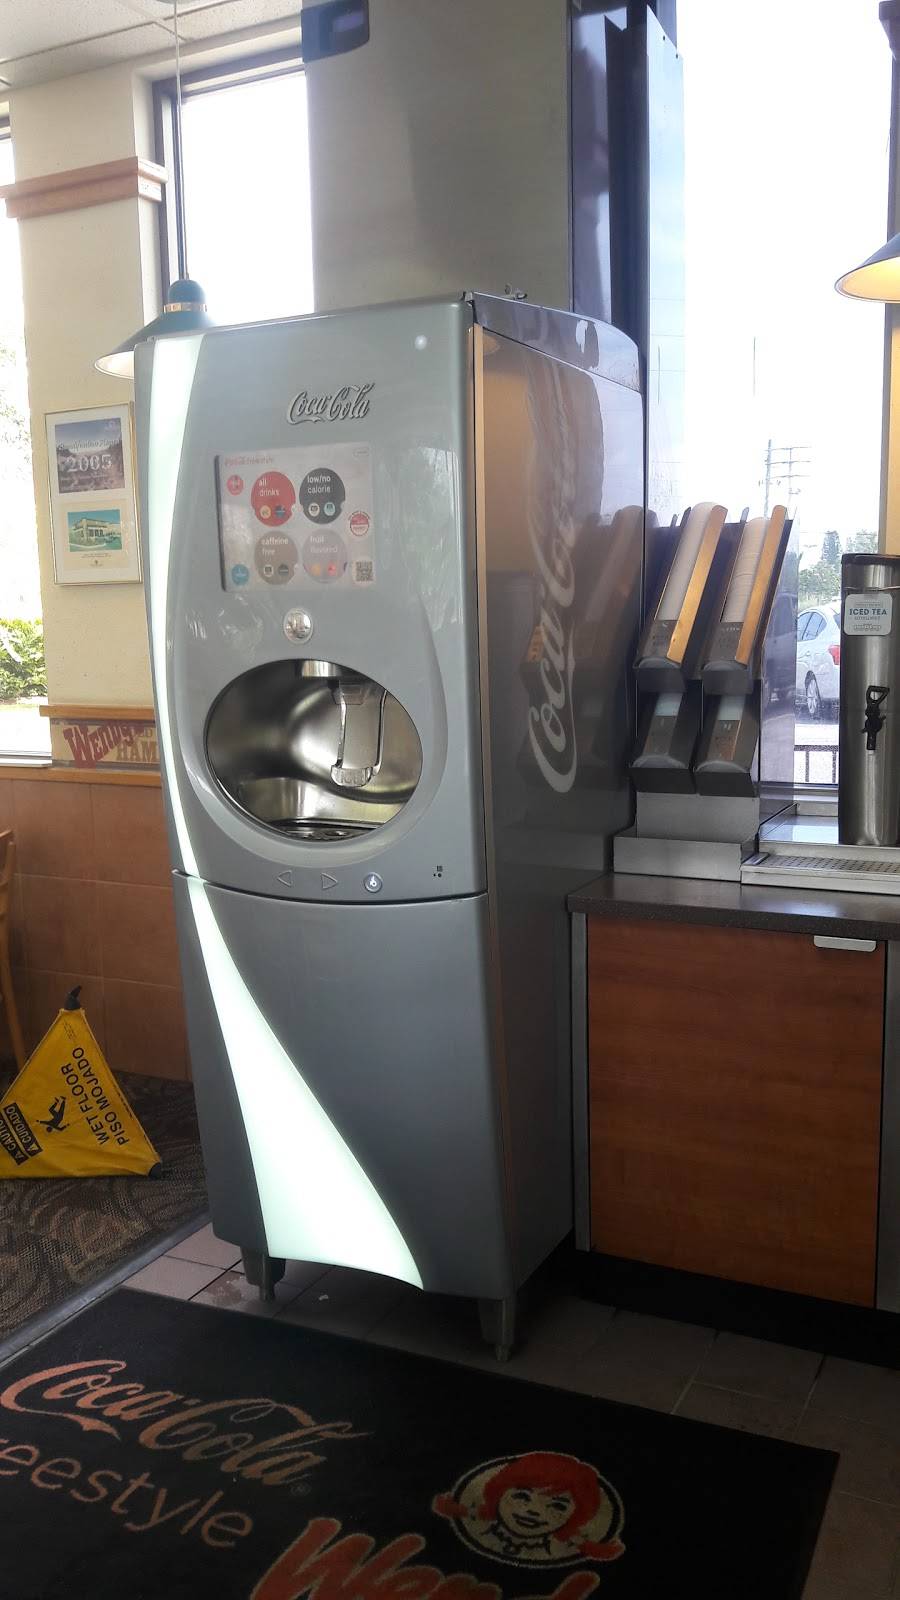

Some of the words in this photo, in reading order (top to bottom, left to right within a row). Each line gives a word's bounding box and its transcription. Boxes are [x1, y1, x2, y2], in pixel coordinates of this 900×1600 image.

[287, 382, 375, 425] Coca-Cola
[258, 478, 268, 487] all
[259, 487, 280, 497] drinks
[307, 474, 331, 484] low/no
[518, 360, 579, 793] Coca-Co
[849, 608, 870, 616] ICED
[871, 608, 888, 616] TEA
[61, 1063, 93, 1113] FLOOR
[72, 1047, 111, 1111] MOJADO
[6, 1106, 32, 1144] CUIDADO
[86, 1115, 110, 1145] WET
[105, 1111, 130, 1146] PISO
[0, 1359, 374, 1486] Coca-Cola
[0, 1437, 253, 1547] eestyle
